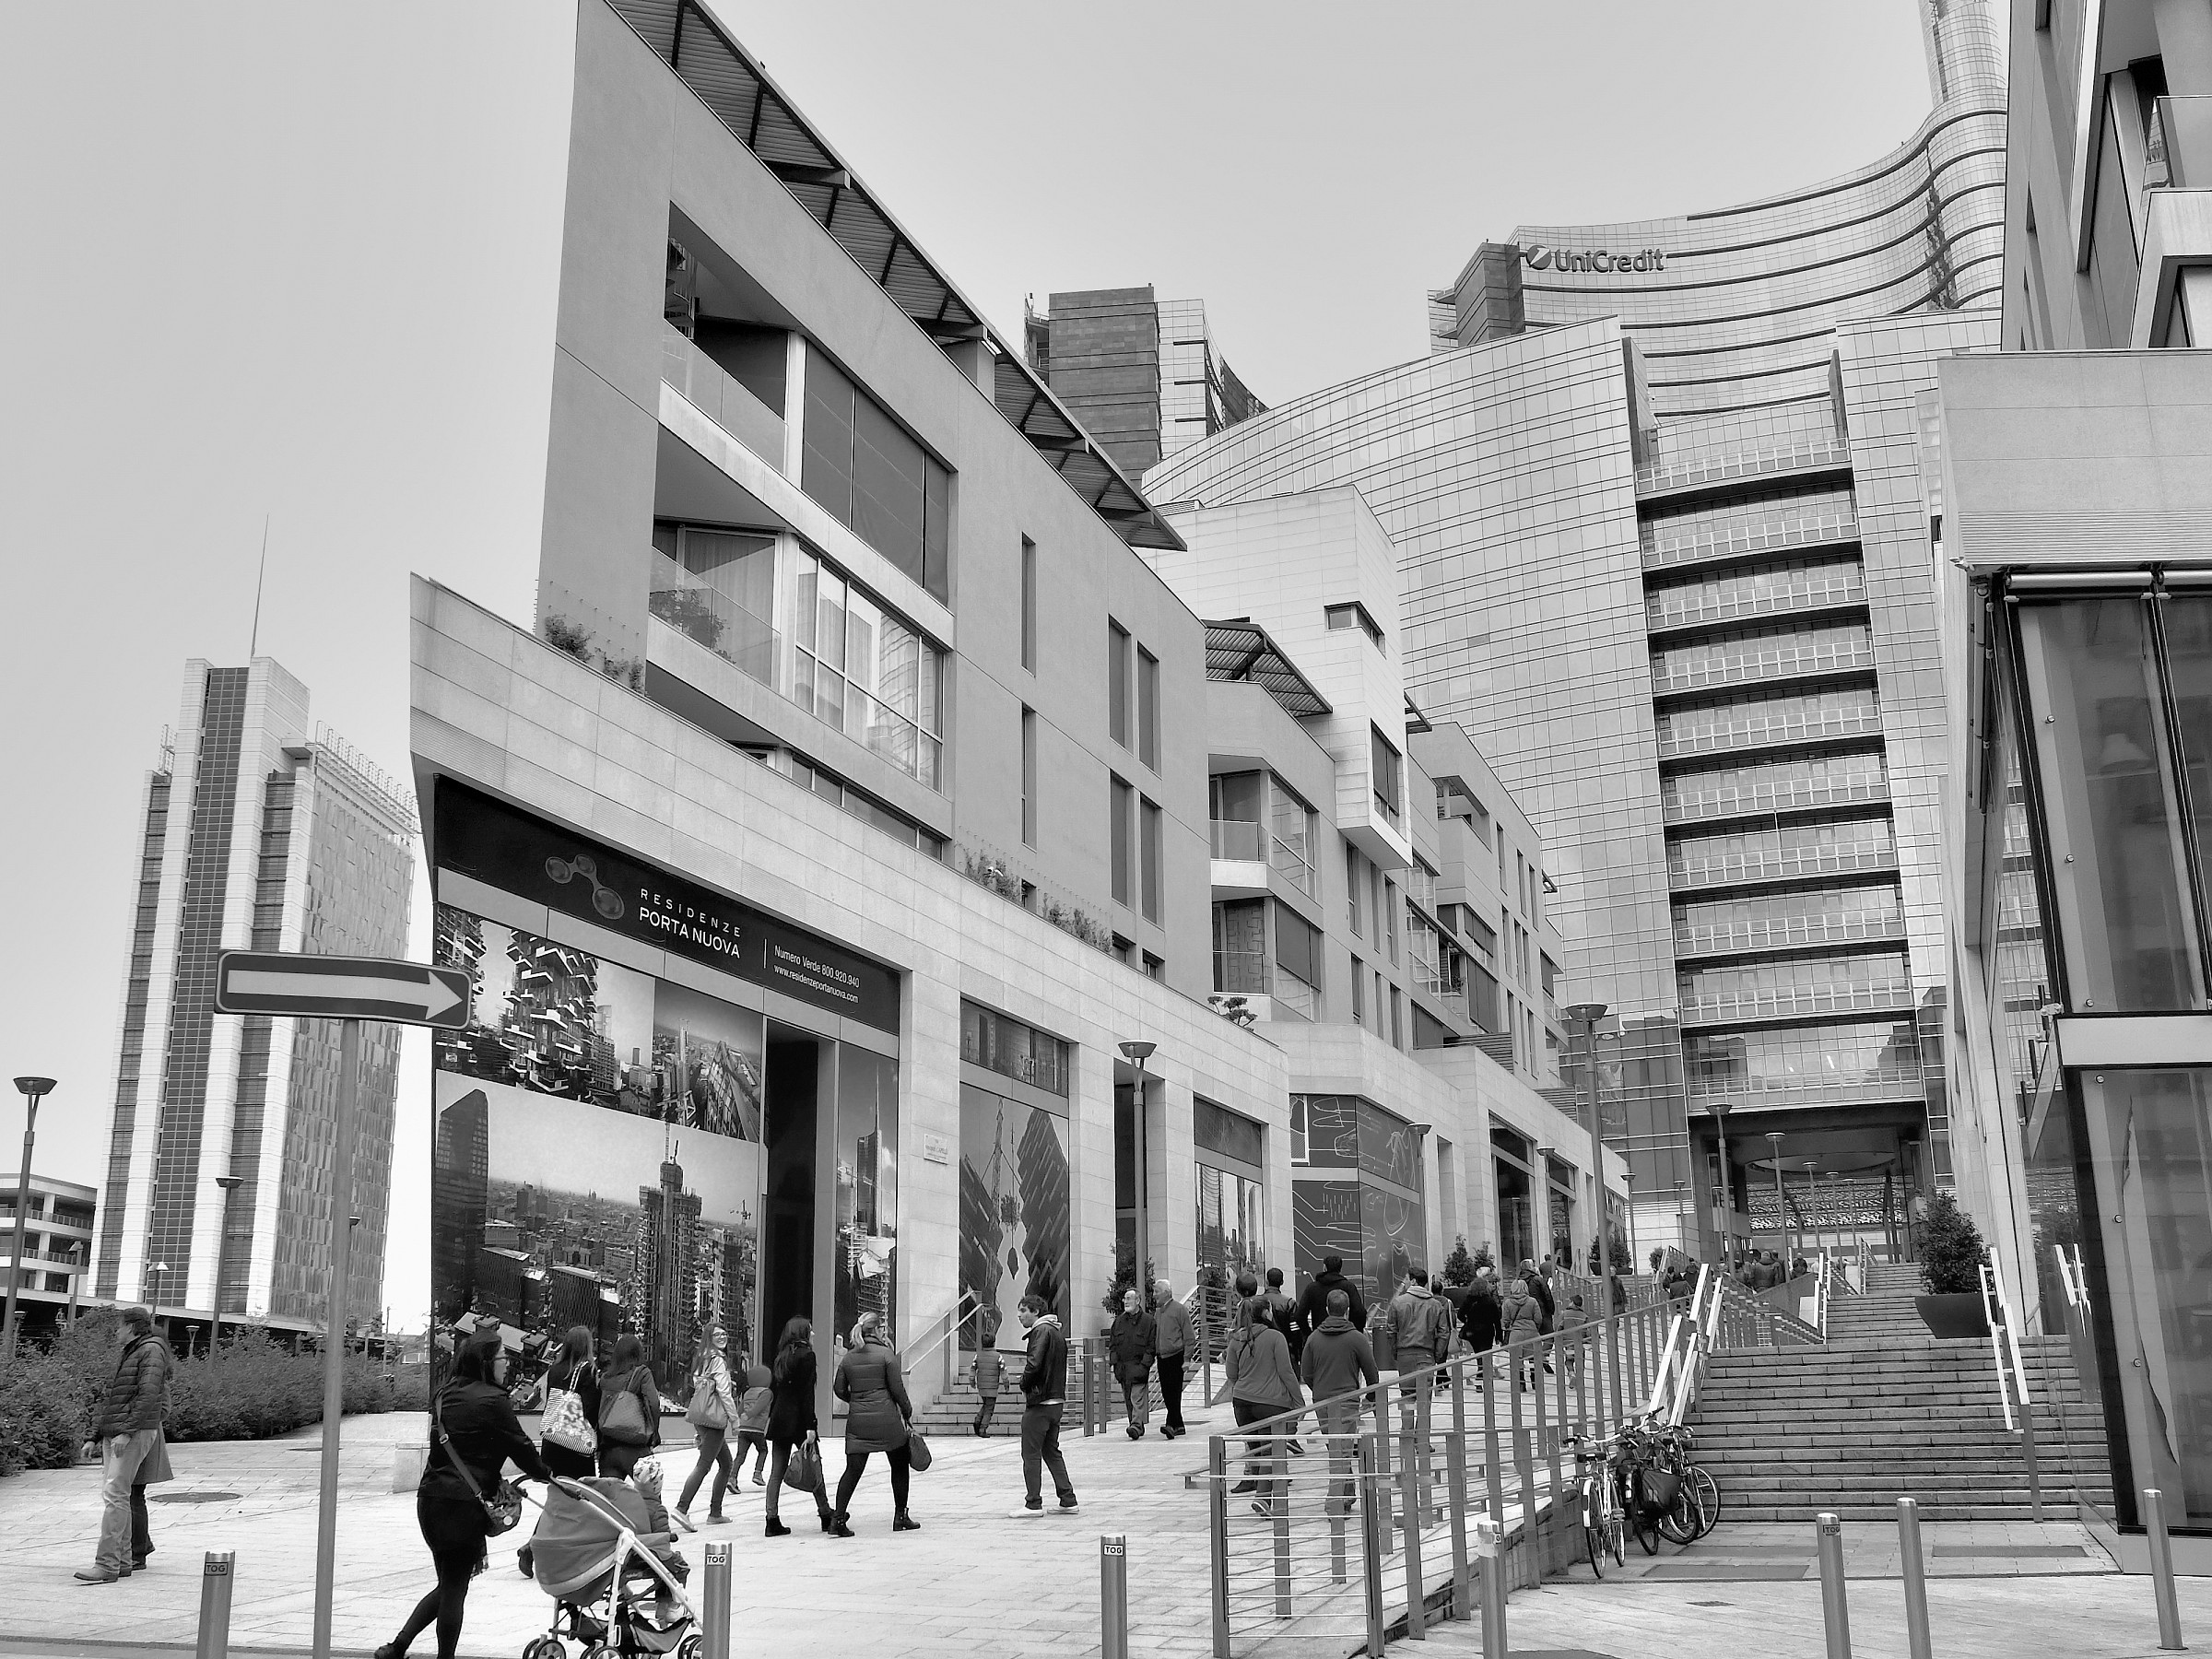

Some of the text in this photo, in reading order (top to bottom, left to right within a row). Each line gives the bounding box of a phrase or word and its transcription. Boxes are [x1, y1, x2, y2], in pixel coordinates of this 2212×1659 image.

[1555, 248, 1665, 274] UniCredit
[640, 906, 740, 959] PORTA NUOVA
[641, 888, 741, 937] RESIDENZE
[773, 964, 859, 1004] www.residenzeportanuova.com
[774, 945, 860, 988] Numero Verde 800.920.940
[206, 1564, 226, 1572] TOG
[1105, 1546, 1123, 1554] TOG
